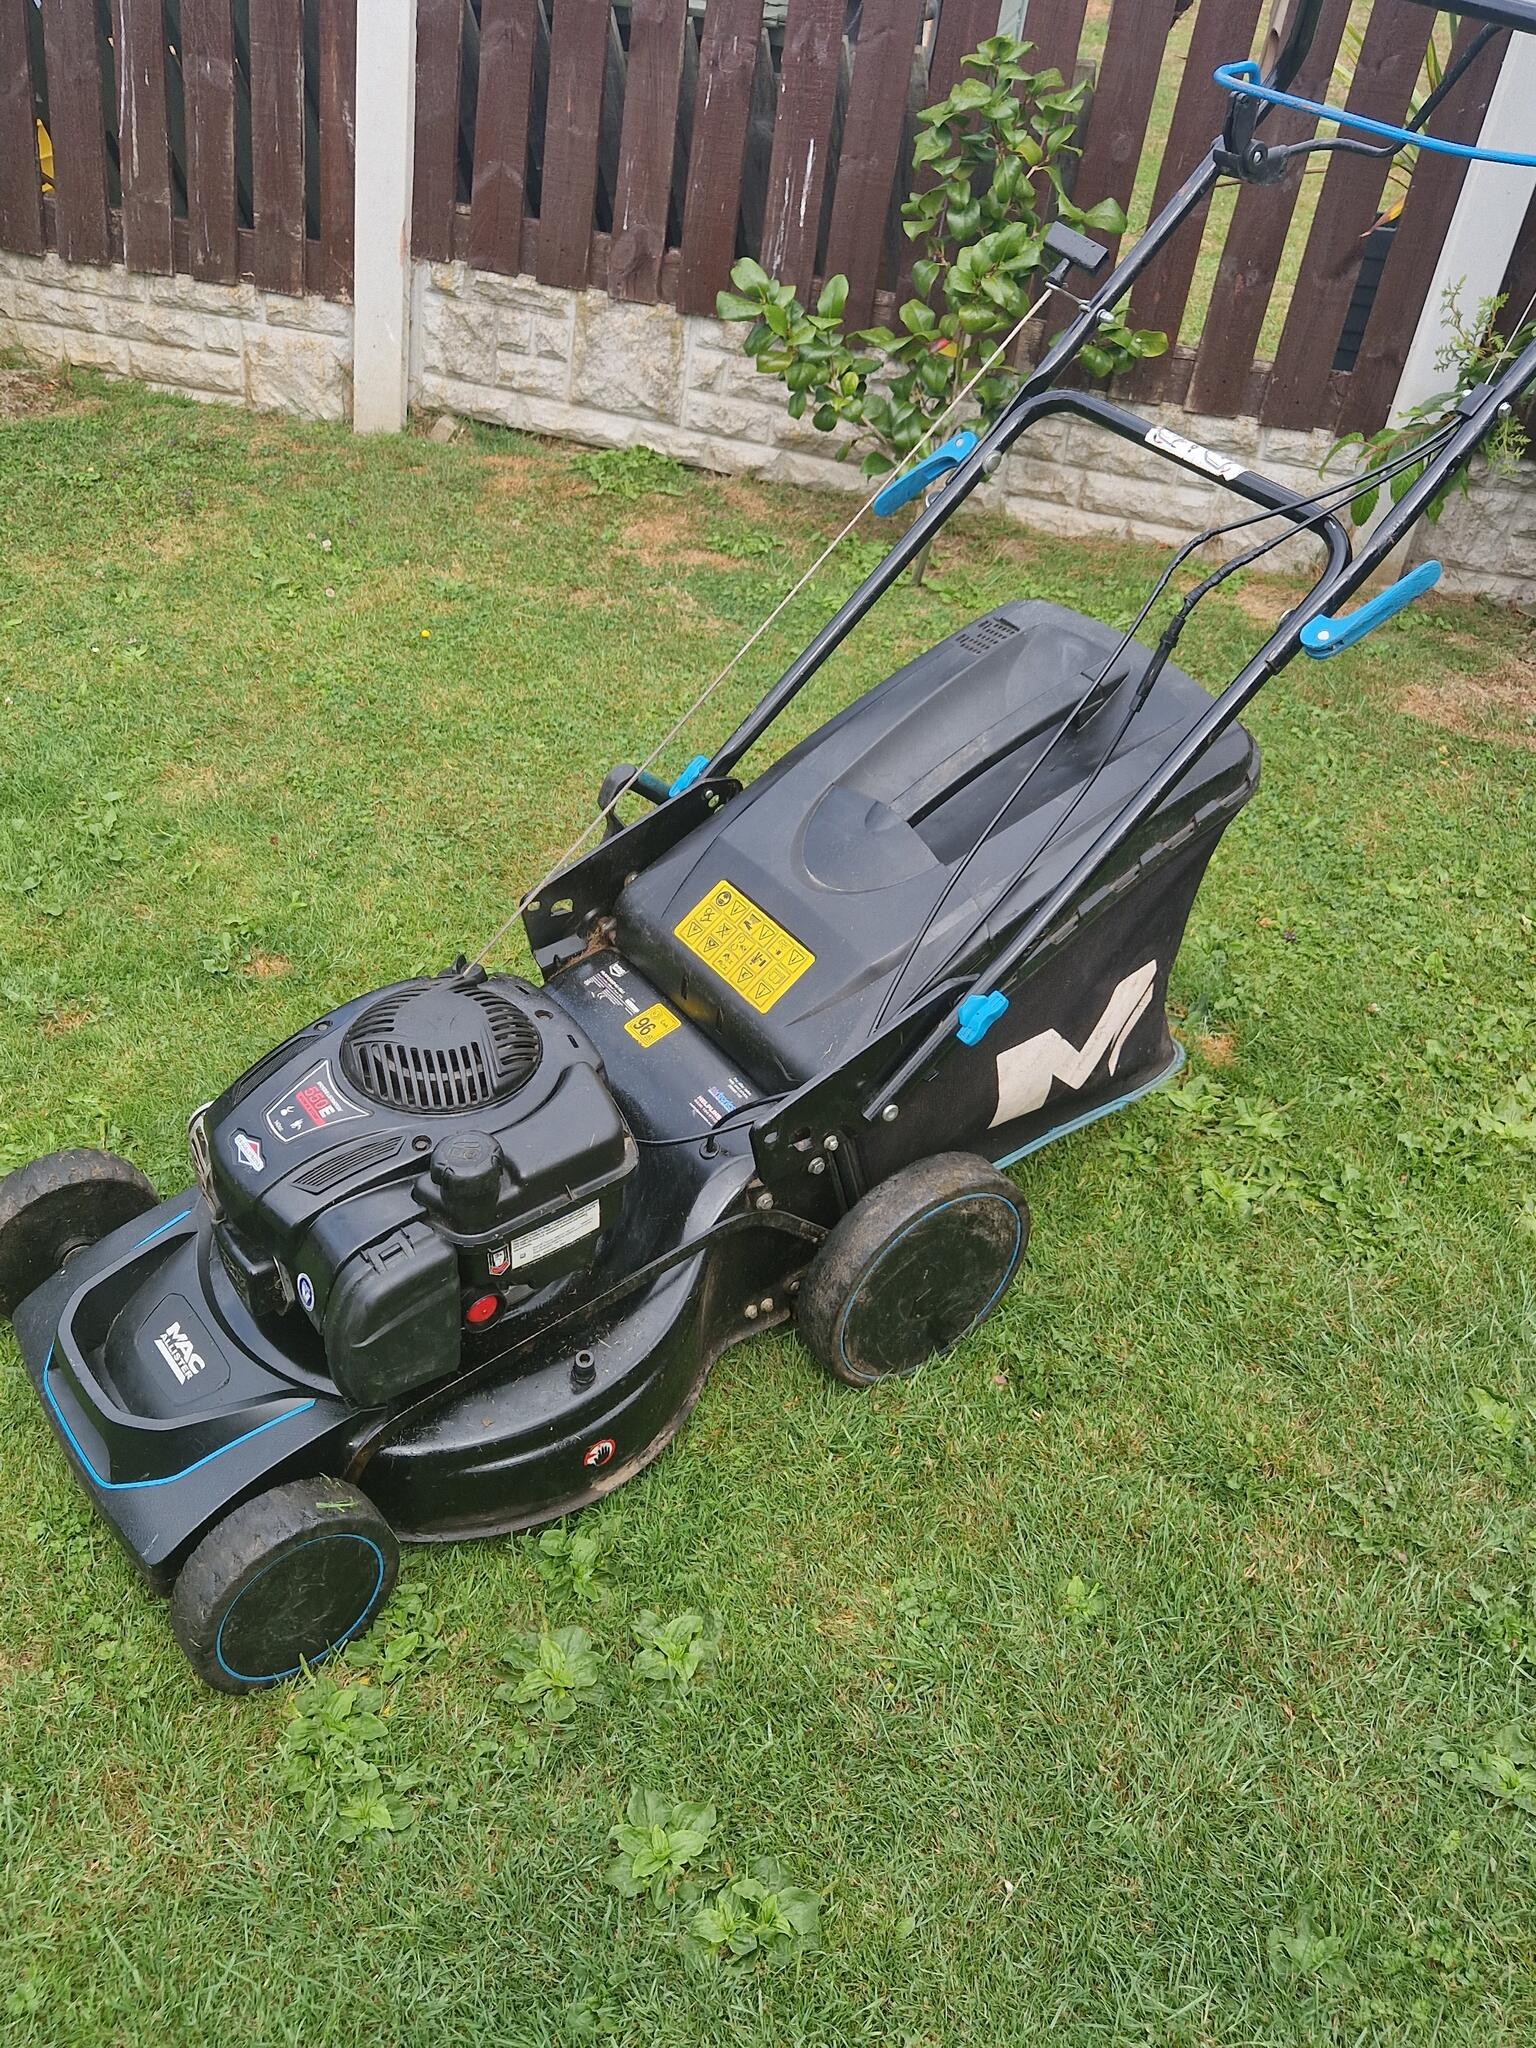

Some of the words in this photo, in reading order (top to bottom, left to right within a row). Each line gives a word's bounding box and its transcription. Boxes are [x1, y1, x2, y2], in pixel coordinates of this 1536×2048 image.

[633, 1017, 656, 1036] 96
[304, 1086, 336, 1119] 550E
[159, 1333, 193, 1381] ALLISTER
[166, 1321, 206, 1375] MAC
